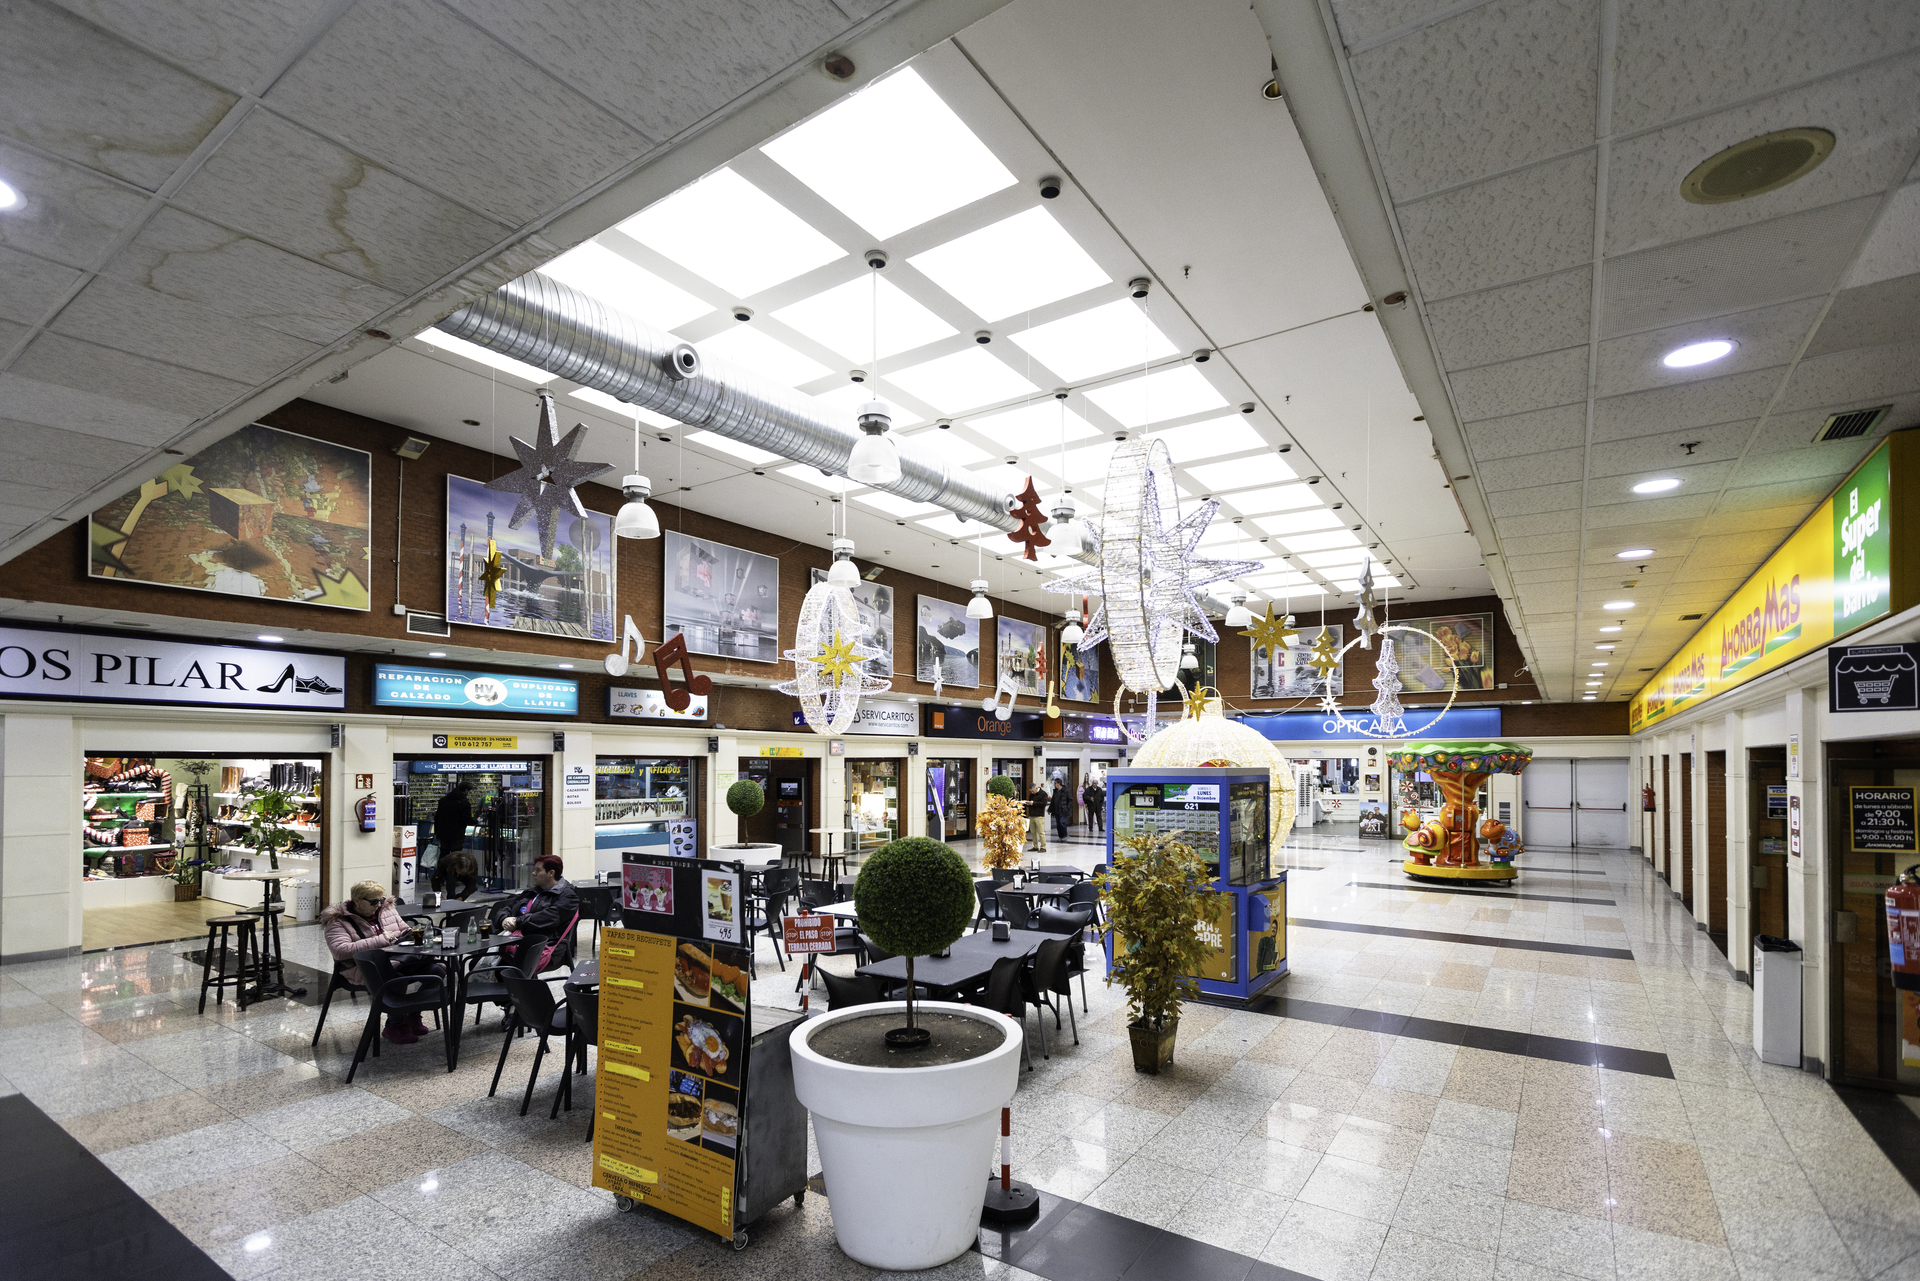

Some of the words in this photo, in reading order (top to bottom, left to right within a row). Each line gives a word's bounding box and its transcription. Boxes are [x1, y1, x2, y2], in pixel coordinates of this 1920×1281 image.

[1849, 487, 1858, 518] El
[1841, 498, 1881, 557] Super
[1849, 549, 1865, 584] del
[1843, 570, 1879, 618] Barrio
[91, 652, 249, 692] PILAR
[378, 672, 463, 685] REPARACION
[474, 683, 495, 694] HV
[512, 682, 577, 693] DUPLICADO
[390, 691, 451, 701] CALZADO
[524, 699, 566, 708] LLAVES
[861, 709, 915, 722] SERVICARRITOS
[977, 715, 1012, 736] Orange
[595, 766, 636, 774] CUCHILLOS
[639, 768, 644, 776] y
[648, 766, 681, 774] AFILADOS
[1855, 792, 1911, 800] HORARIO
[1875, 810, 1901, 818] 9:00
[1867, 818, 1895, 826] 21:30
[1896, 818, 1908, 826] h.
[794, 917, 822, 928] PROHIBIDO
[606, 930, 626, 940] TAPAS
[626, 933, 636, 941] DE
[799, 930, 805, 940] EL
[805, 930, 819, 940] PASO
[787, 942, 809, 952] TERRAZA
[809, 941, 832, 951] CERRADA
[602, 1171, 623, 1183] CERVEZA
[628, 1180, 652, 1193] REFRESCO
[612, 1184, 624, 1192] TAPA
